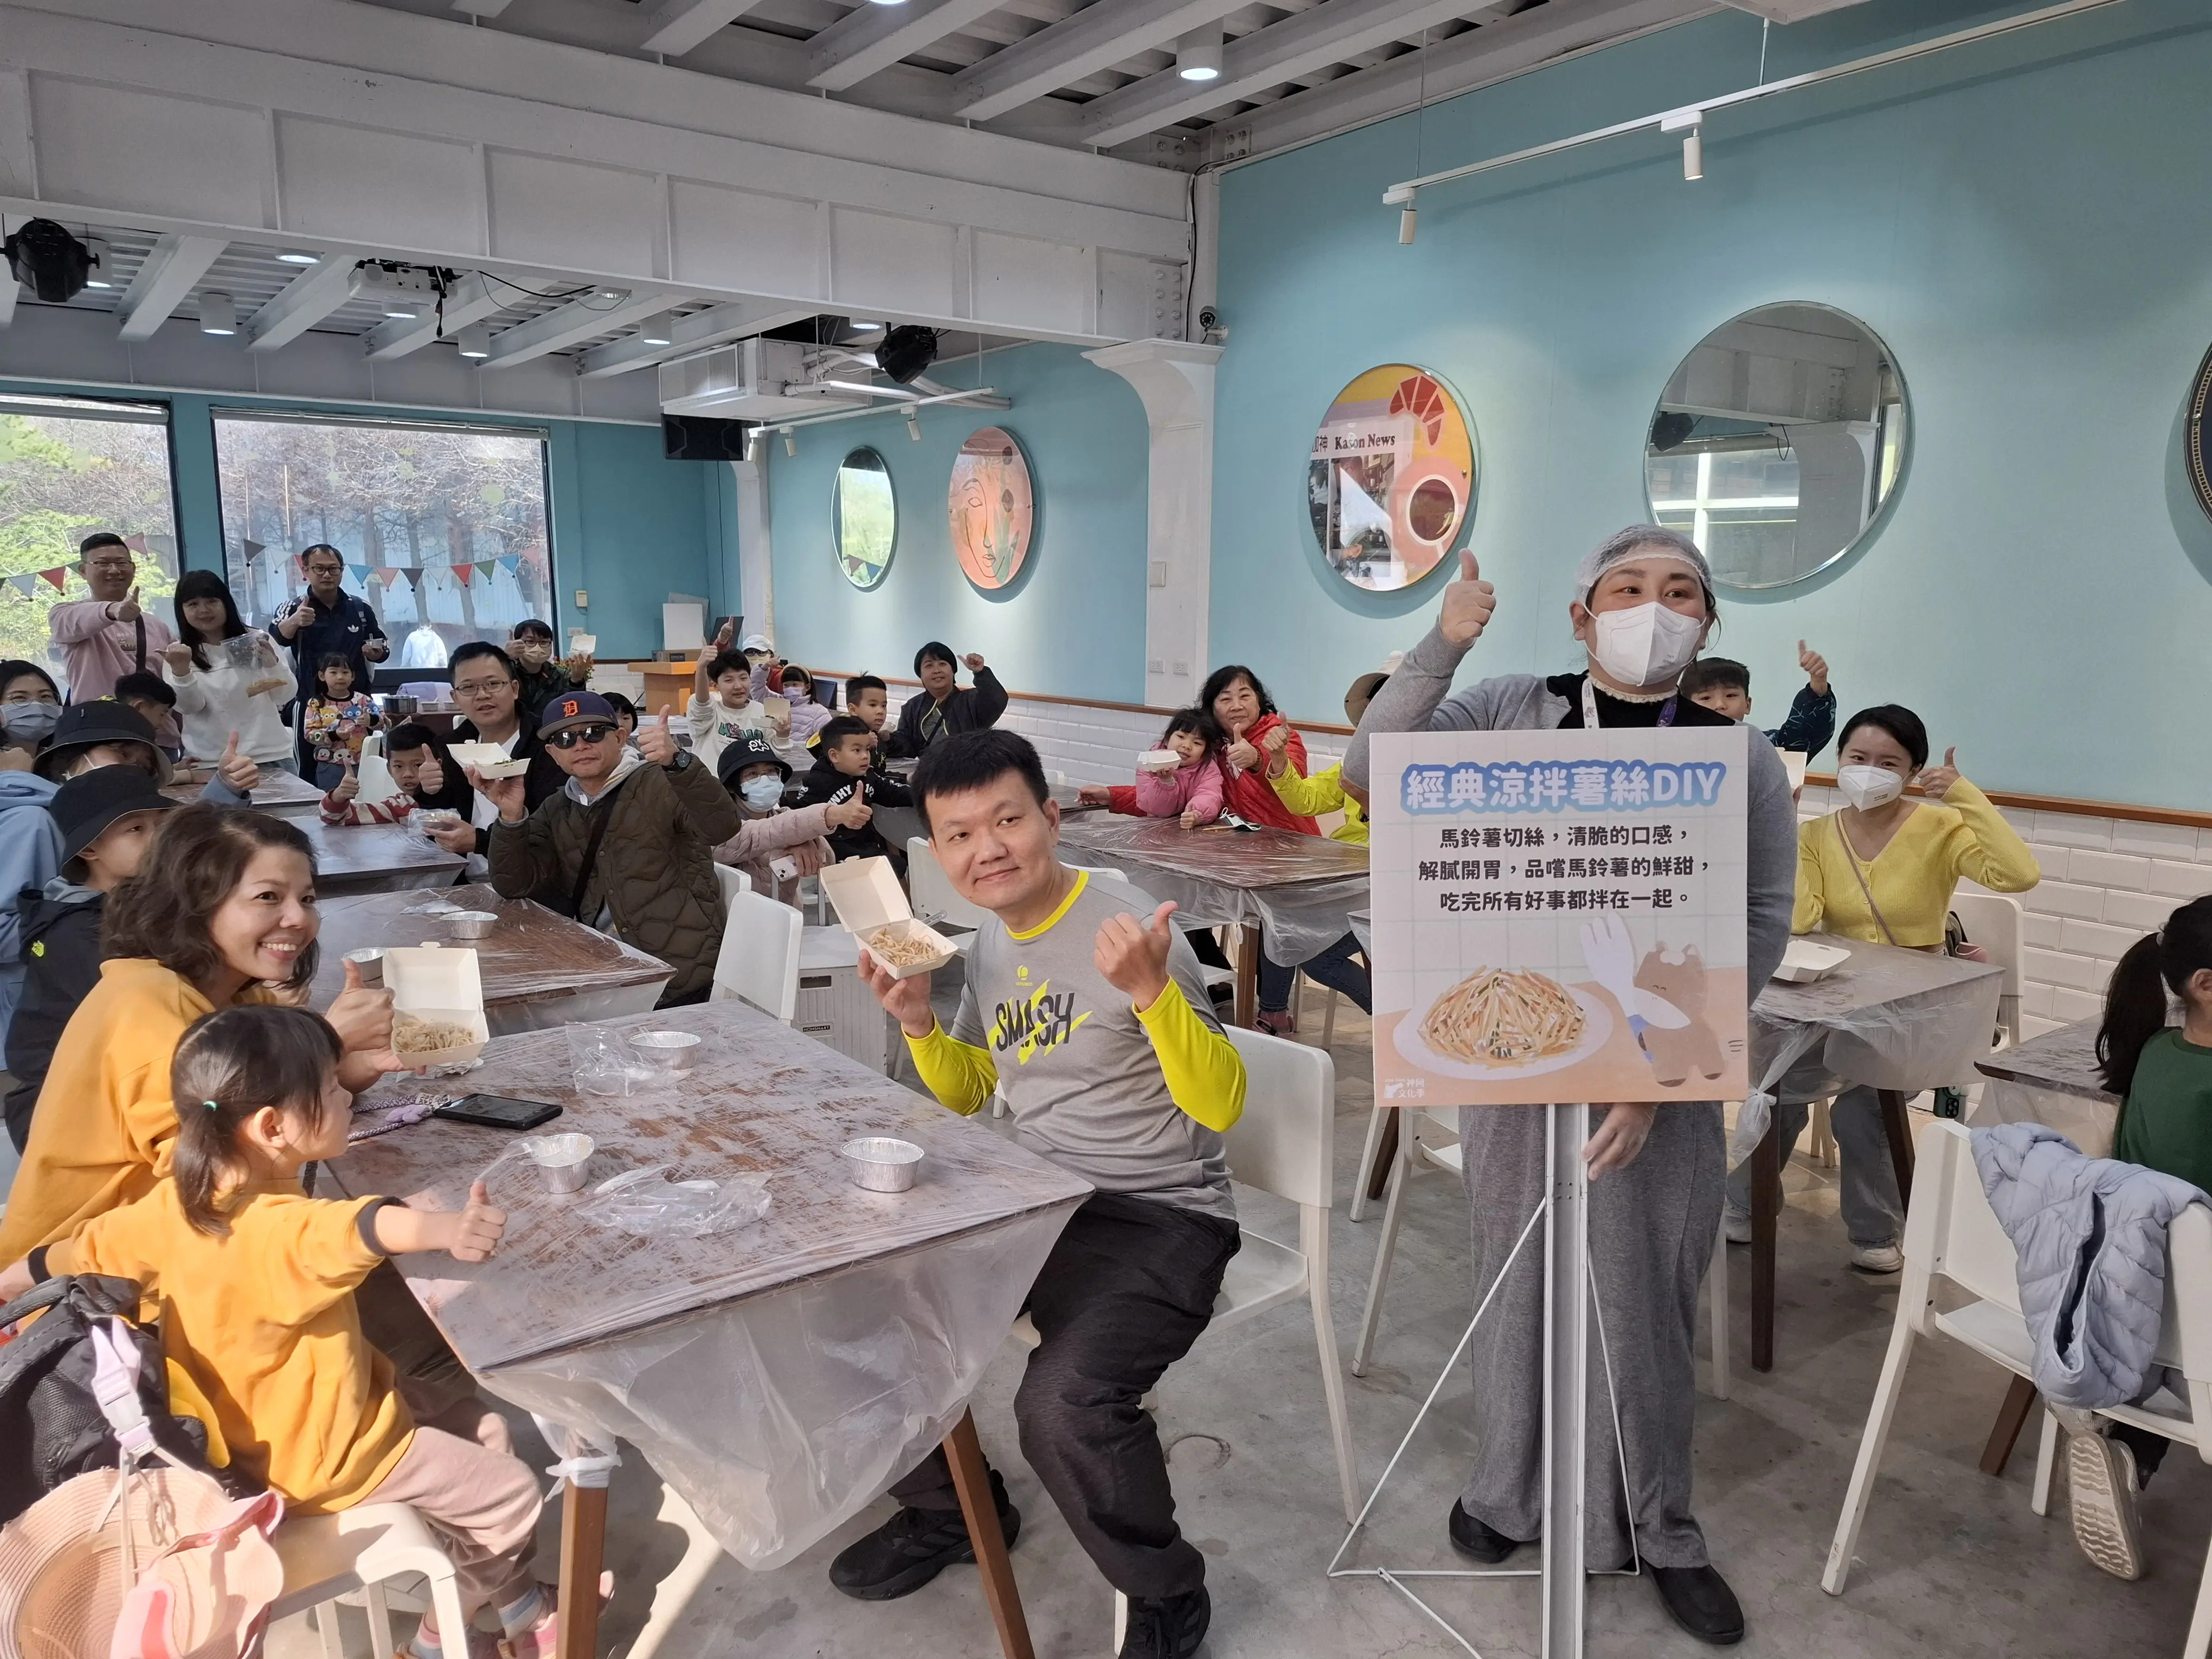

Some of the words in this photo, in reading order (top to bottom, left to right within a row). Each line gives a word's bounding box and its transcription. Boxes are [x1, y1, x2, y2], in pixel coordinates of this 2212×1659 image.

[1367, 433, 1395, 447] News
[562, 700, 578, 717] D
[1407, 766, 1720, 809] 經典涼拌薯絲DIY
[1439, 825, 1687, 848] 馬鈴薯切絲，清脆的口感，
[1418, 856, 1708, 880] 解膩開胃，品嚐馬鈴薯的鮮甜，
[1440, 888, 1688, 912] 吃完所有好事都拌在一起。
[995, 993, 1075, 1052] SMASH
